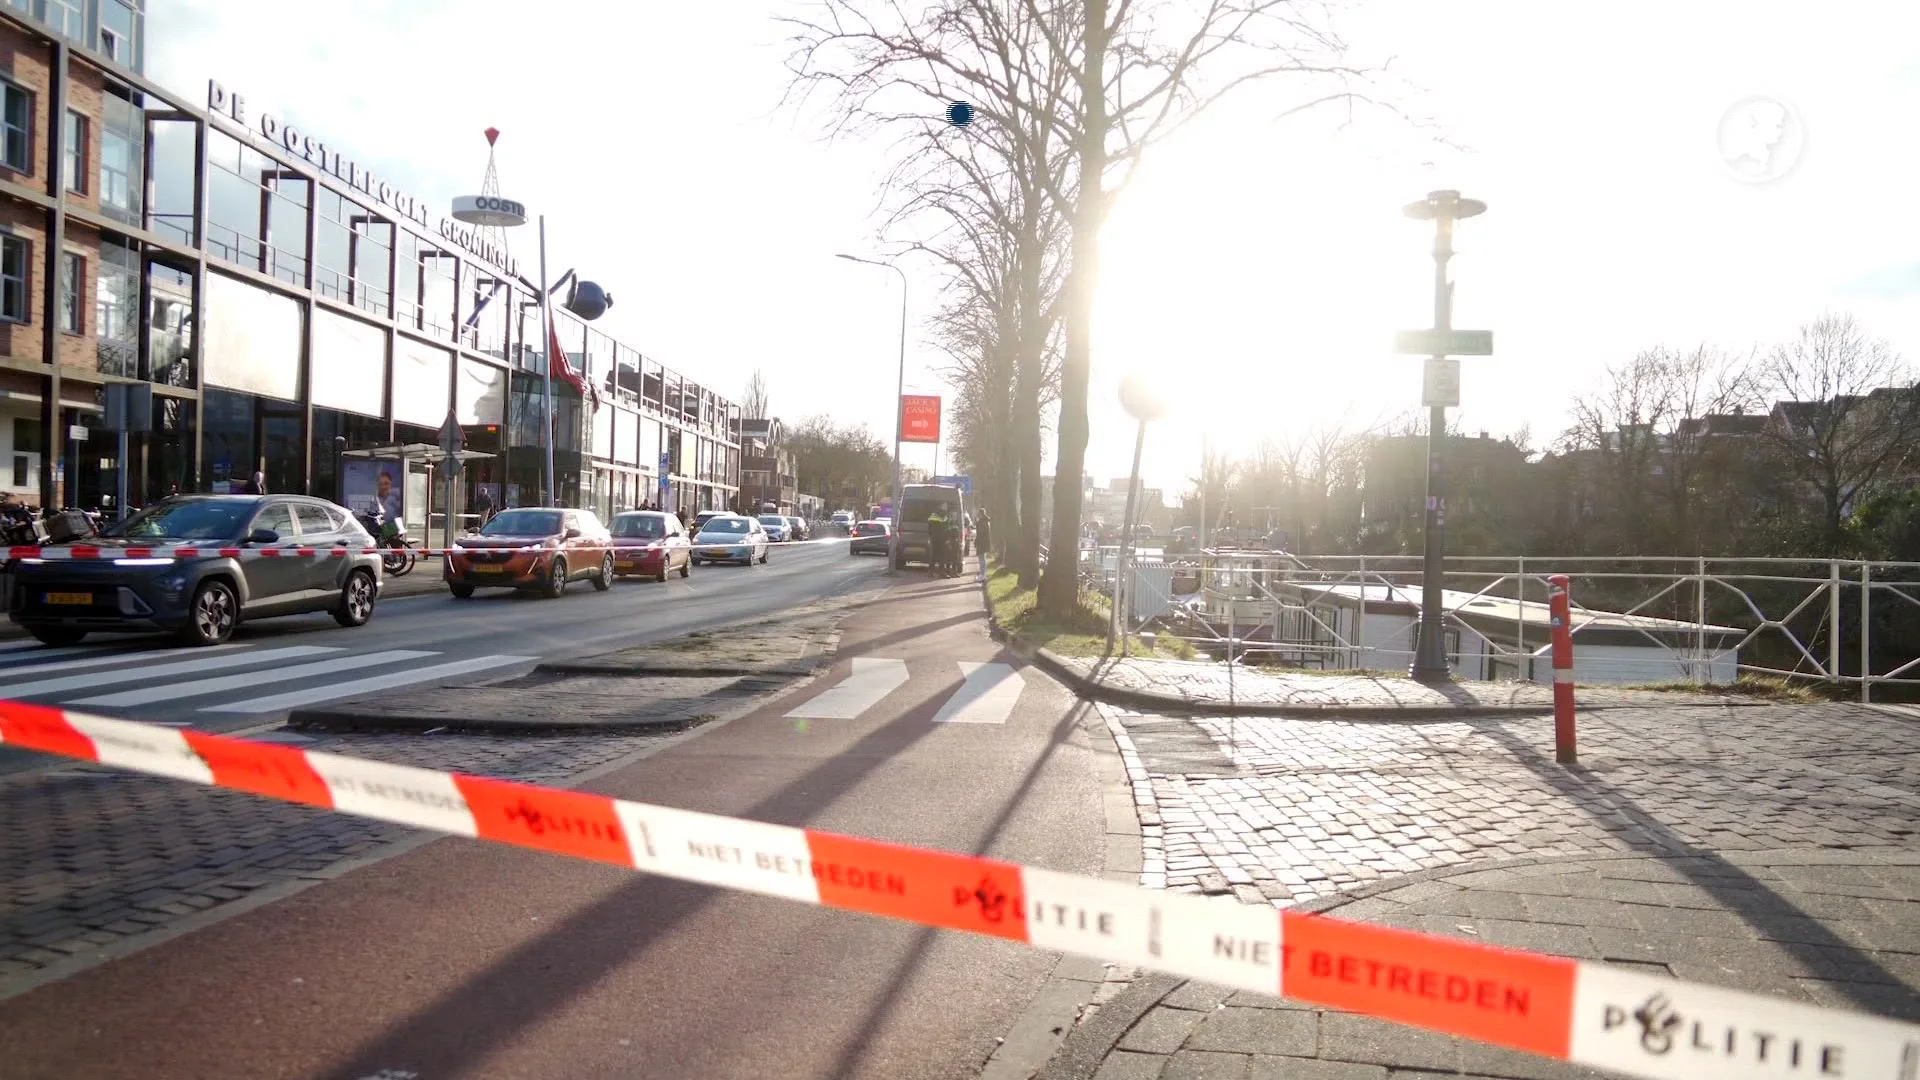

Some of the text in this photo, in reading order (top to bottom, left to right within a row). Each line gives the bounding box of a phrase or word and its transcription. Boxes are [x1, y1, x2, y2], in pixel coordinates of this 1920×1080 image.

[208, 78, 246, 124] DE
[261, 112, 428, 228] OOSTERPOORT
[687, 838, 742, 864] NIET
[755, 850, 906, 896] BETREDEN
[954, 872, 1114, 935] POLITIE
[1214, 933, 1532, 1018] NIET BETREDEN
[1604, 993, 1845, 1074] POLITIE
